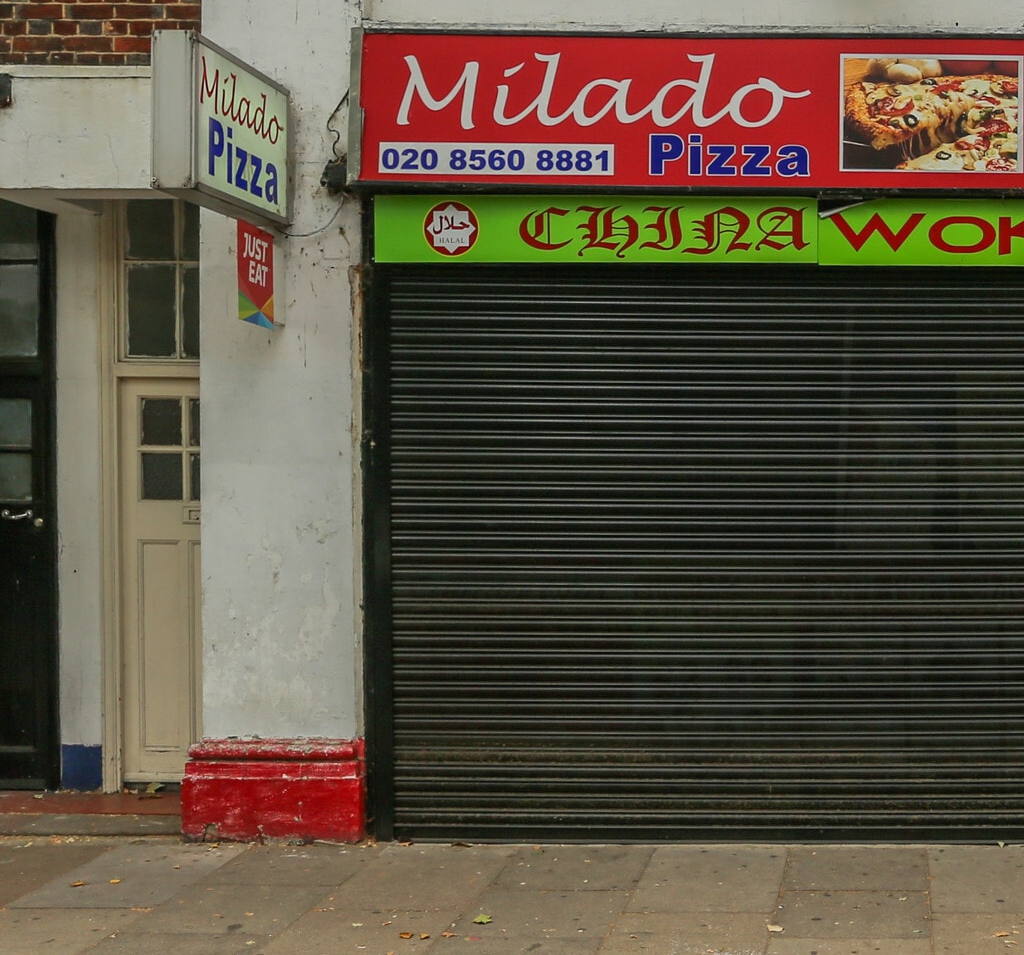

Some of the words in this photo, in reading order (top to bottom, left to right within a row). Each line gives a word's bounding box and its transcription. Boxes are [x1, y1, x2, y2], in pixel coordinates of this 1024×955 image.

[200, 56, 284, 145] Milado
[396, 51, 811, 130] Milado
[208, 116, 278, 205] Pizza
[381, 148, 438, 171] 020
[449, 149, 526, 172] 8560
[535, 149, 610, 172] 8881
[648, 132, 811, 178] Pizza
[243, 232, 268, 261] JUST
[432, 215, 470, 235] حلال
[518, 205, 811, 258] CHINA
[248, 265, 268, 288] EAT
